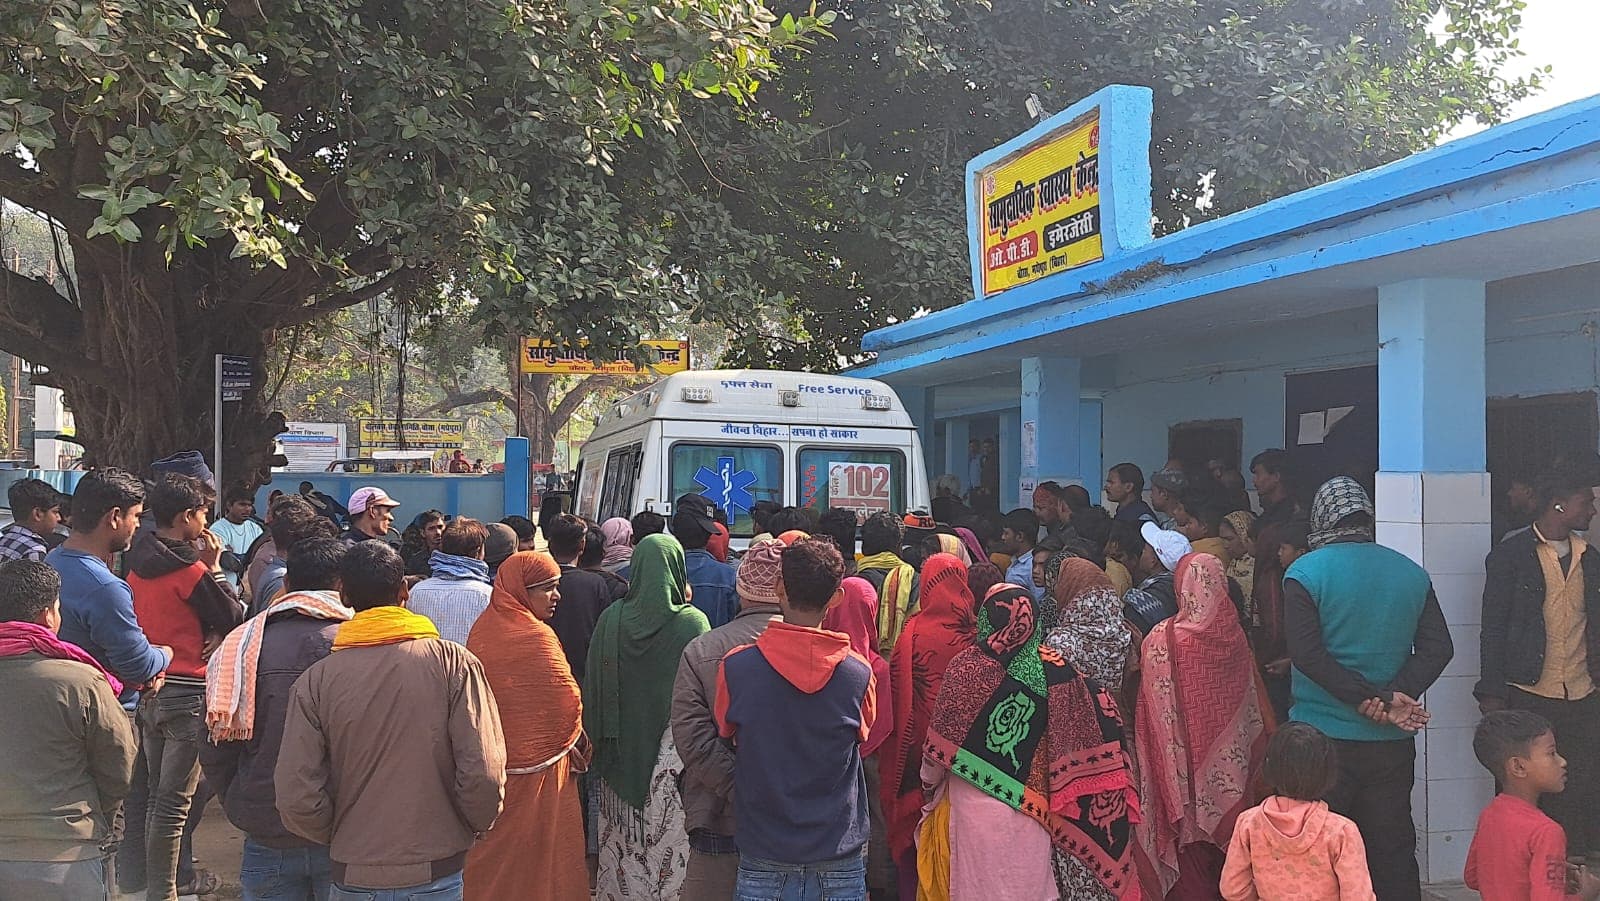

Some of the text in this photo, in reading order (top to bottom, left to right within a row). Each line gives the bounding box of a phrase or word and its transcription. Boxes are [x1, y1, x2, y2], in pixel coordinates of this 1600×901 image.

[1047, 211, 1094, 249] इमेरजेंसी
[748, 379, 774, 389] सेवा
[798, 383, 872, 397] Free Service
[791, 428, 816, 438] सपना
[818, 427, 828, 440] हो
[843, 465, 889, 497] 102
